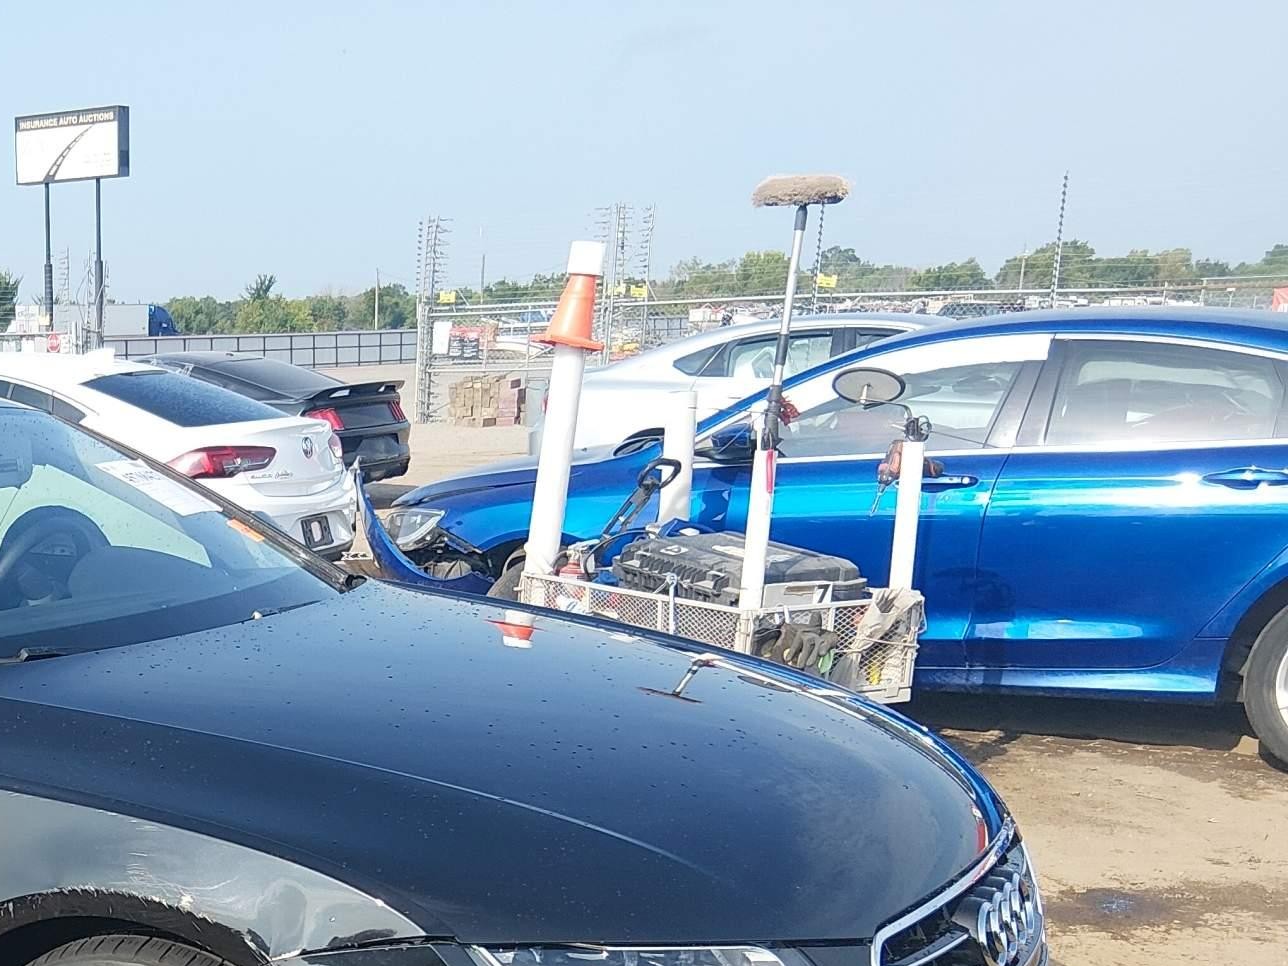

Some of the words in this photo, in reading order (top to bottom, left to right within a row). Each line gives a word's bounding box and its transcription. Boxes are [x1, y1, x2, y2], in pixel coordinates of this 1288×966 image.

[19, 118, 58, 130] INSURANCE
[58, 116, 78, 126] AUTO
[78, 112, 114, 124] AUCTIONS
